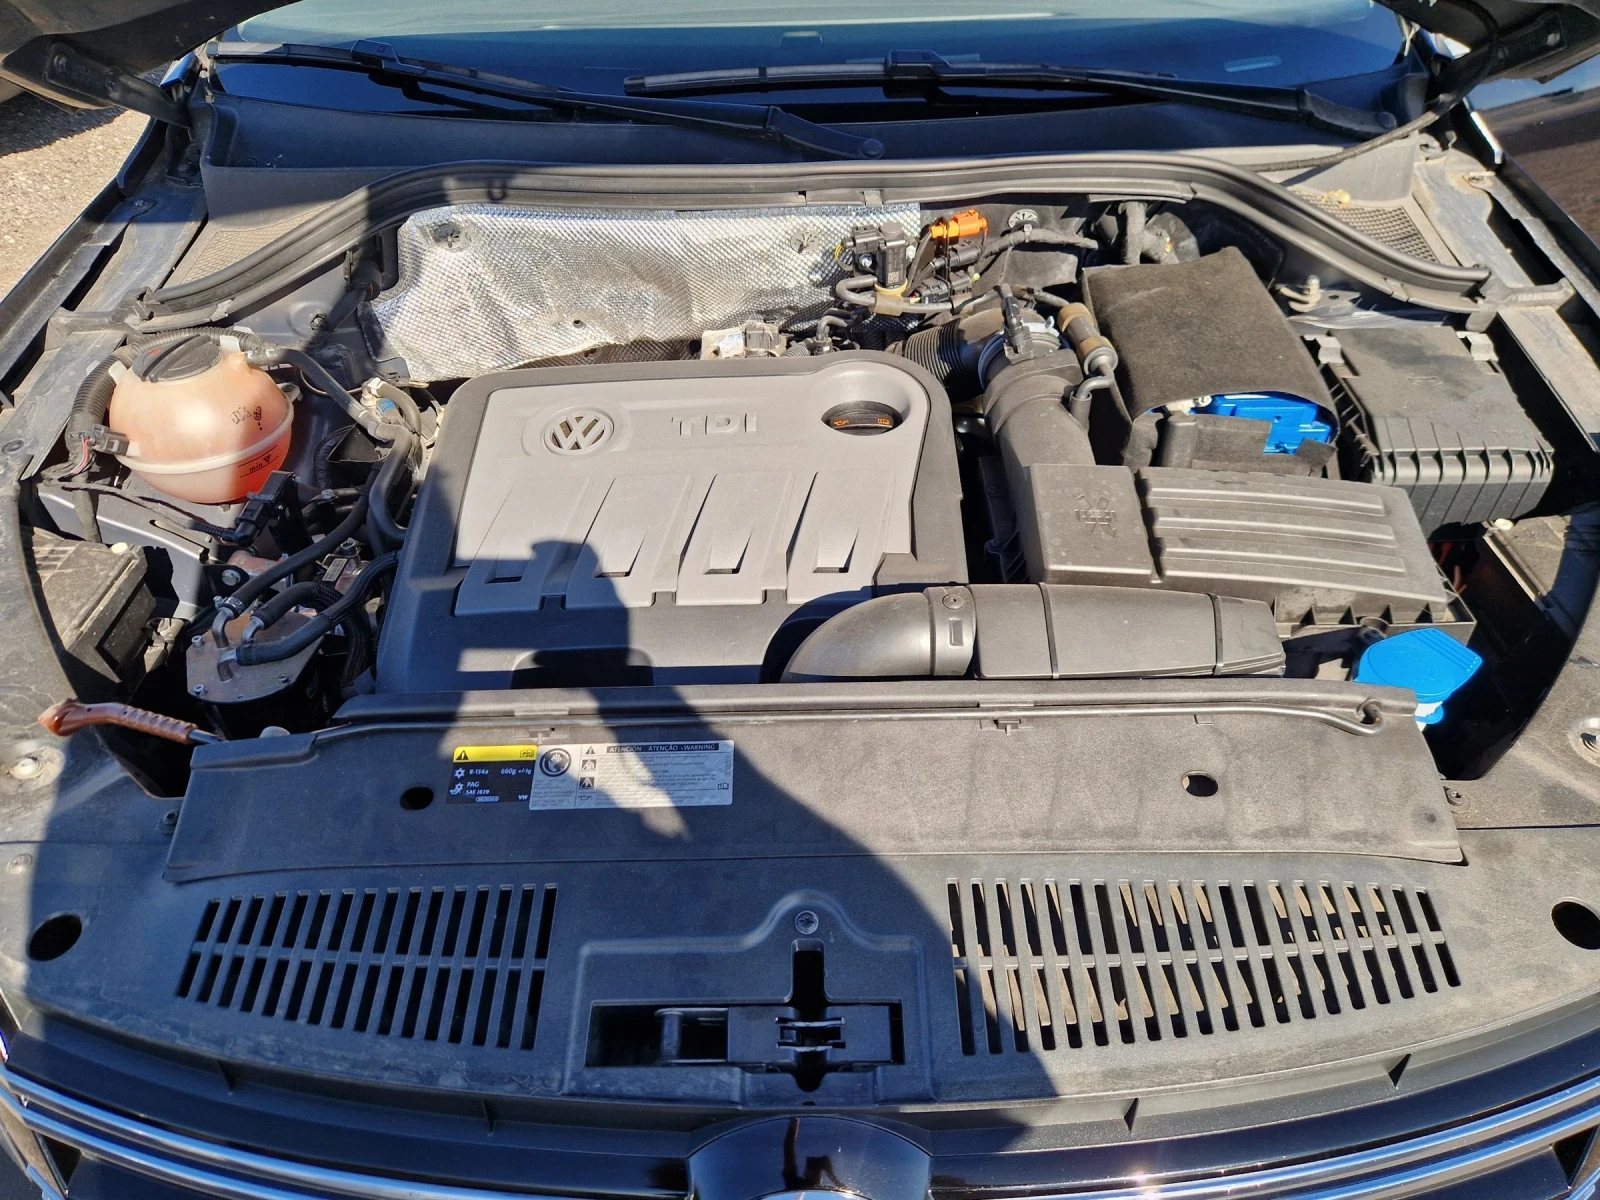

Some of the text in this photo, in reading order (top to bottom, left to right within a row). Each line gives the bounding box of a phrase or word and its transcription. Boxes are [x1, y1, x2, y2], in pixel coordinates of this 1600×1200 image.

[670, 412, 760, 437] TDI
[249, 462, 263, 472] min
[648, 744, 678, 753] ATENÇÃO
[683, 743, 715, 751] WARNING
[500, 767, 517, 776] 660g
[466, 780, 480, 788] PAG
